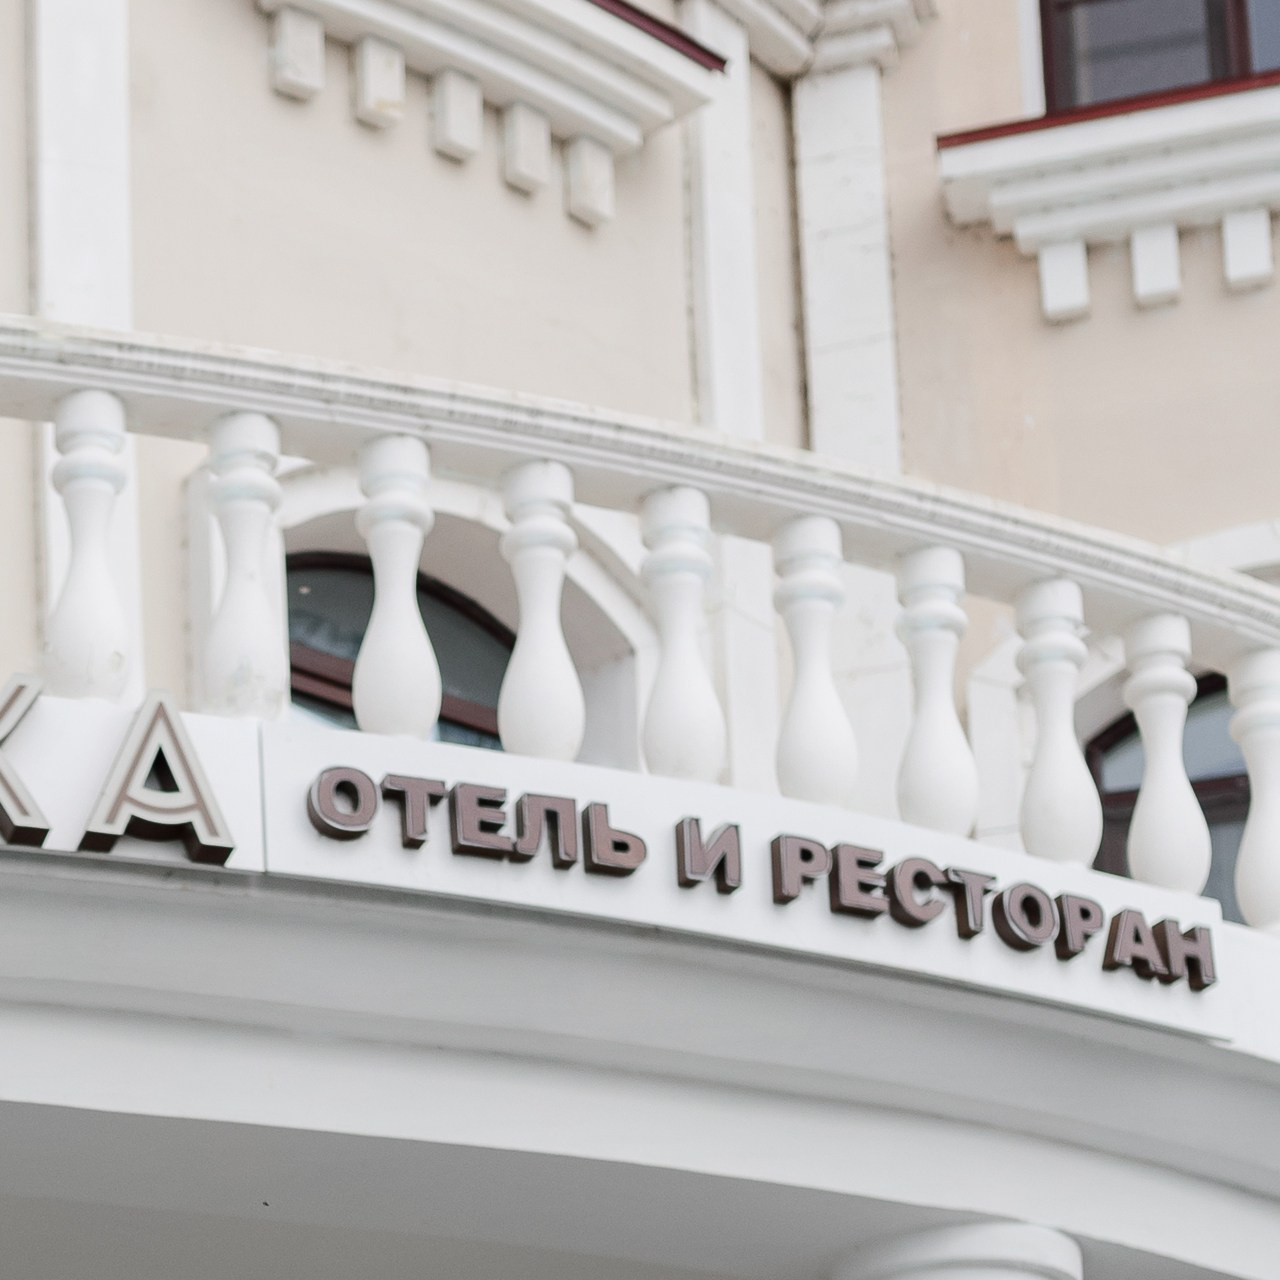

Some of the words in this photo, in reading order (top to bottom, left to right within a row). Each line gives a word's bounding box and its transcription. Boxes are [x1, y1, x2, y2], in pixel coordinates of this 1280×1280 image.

[308, 766, 647, 877] ОТЕЛЬ
[677, 816, 744, 893] И
[771, 832, 1217, 990] РЕСТОРАН
